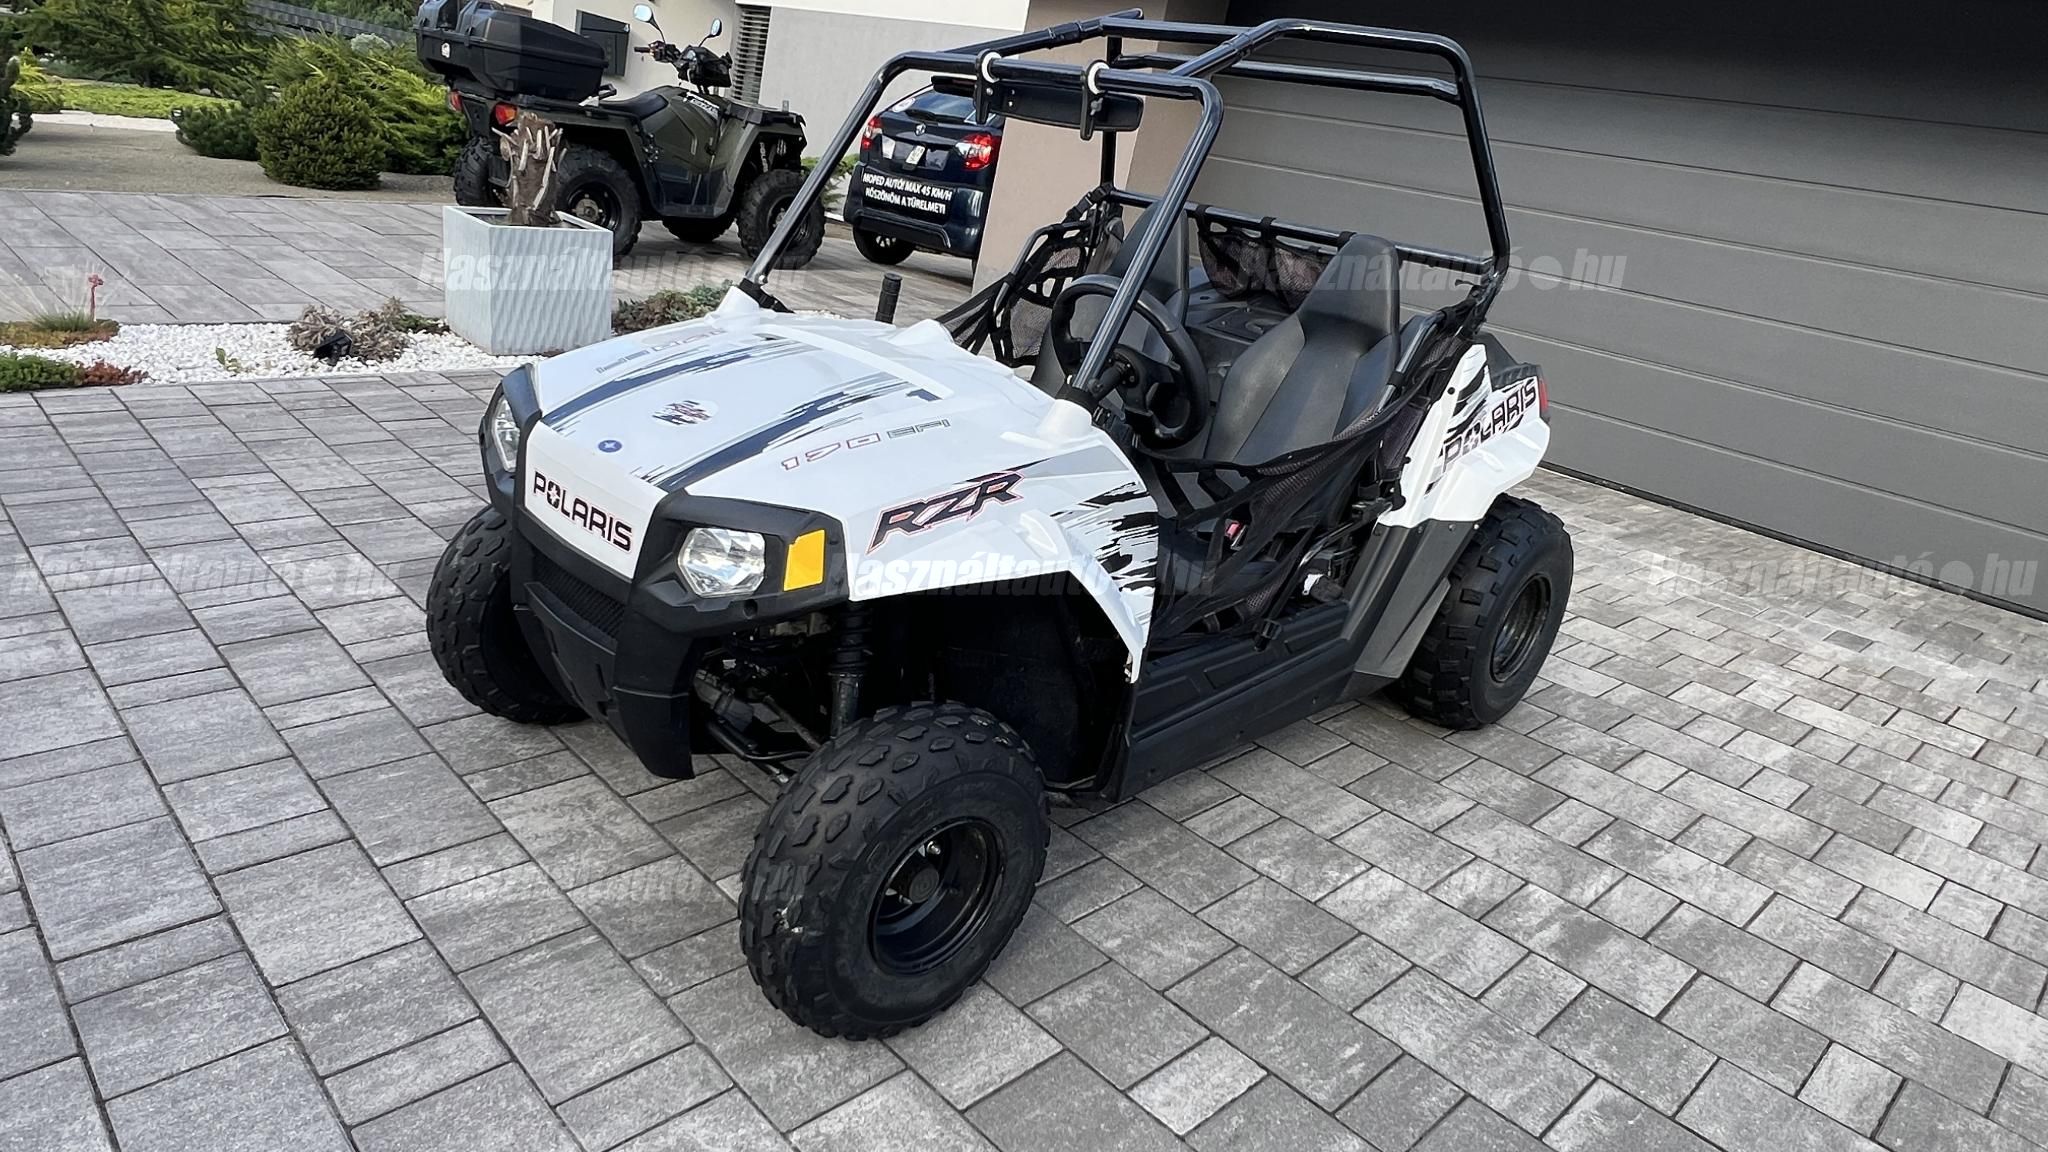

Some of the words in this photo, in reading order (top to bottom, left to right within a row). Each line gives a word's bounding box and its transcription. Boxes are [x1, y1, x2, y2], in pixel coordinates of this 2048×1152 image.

[862, 172, 885, 186] MOPED
[905, 180, 922, 195] MAX
[921, 184, 931, 196] 45
[930, 186, 953, 201] KM/H
[1442, 378, 1537, 473] POLARIS
[533, 471, 633, 552] POLARIS
[866, 471, 1025, 555] RZR
